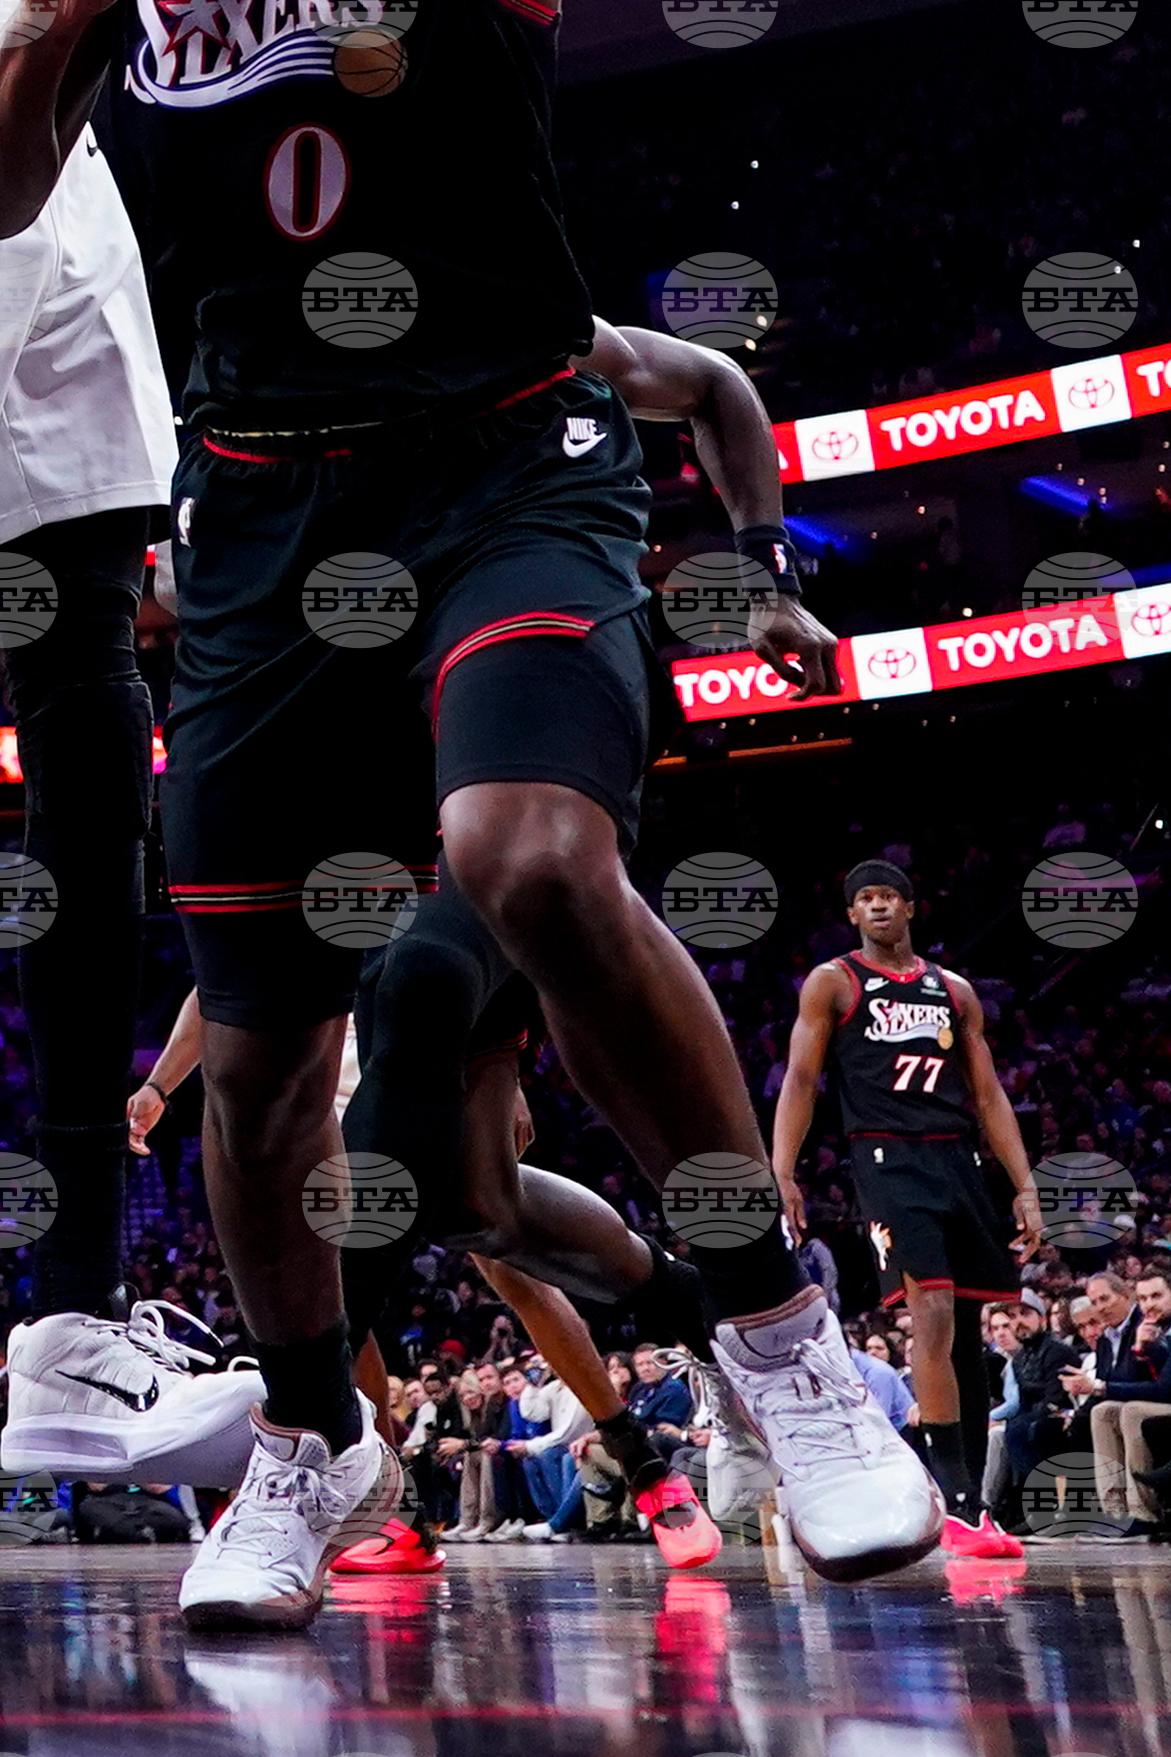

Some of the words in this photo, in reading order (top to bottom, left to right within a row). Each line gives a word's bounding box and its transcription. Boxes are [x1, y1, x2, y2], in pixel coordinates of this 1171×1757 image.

[263, 121, 352, 242] 0
[566, 417, 597, 441] NIKE
[880, 389, 1046, 452] TOYOTA
[937, 613, 1109, 671] TOYOTA
[674, 658, 804, 707] TOYO
[892, 1052, 947, 1094] 77
